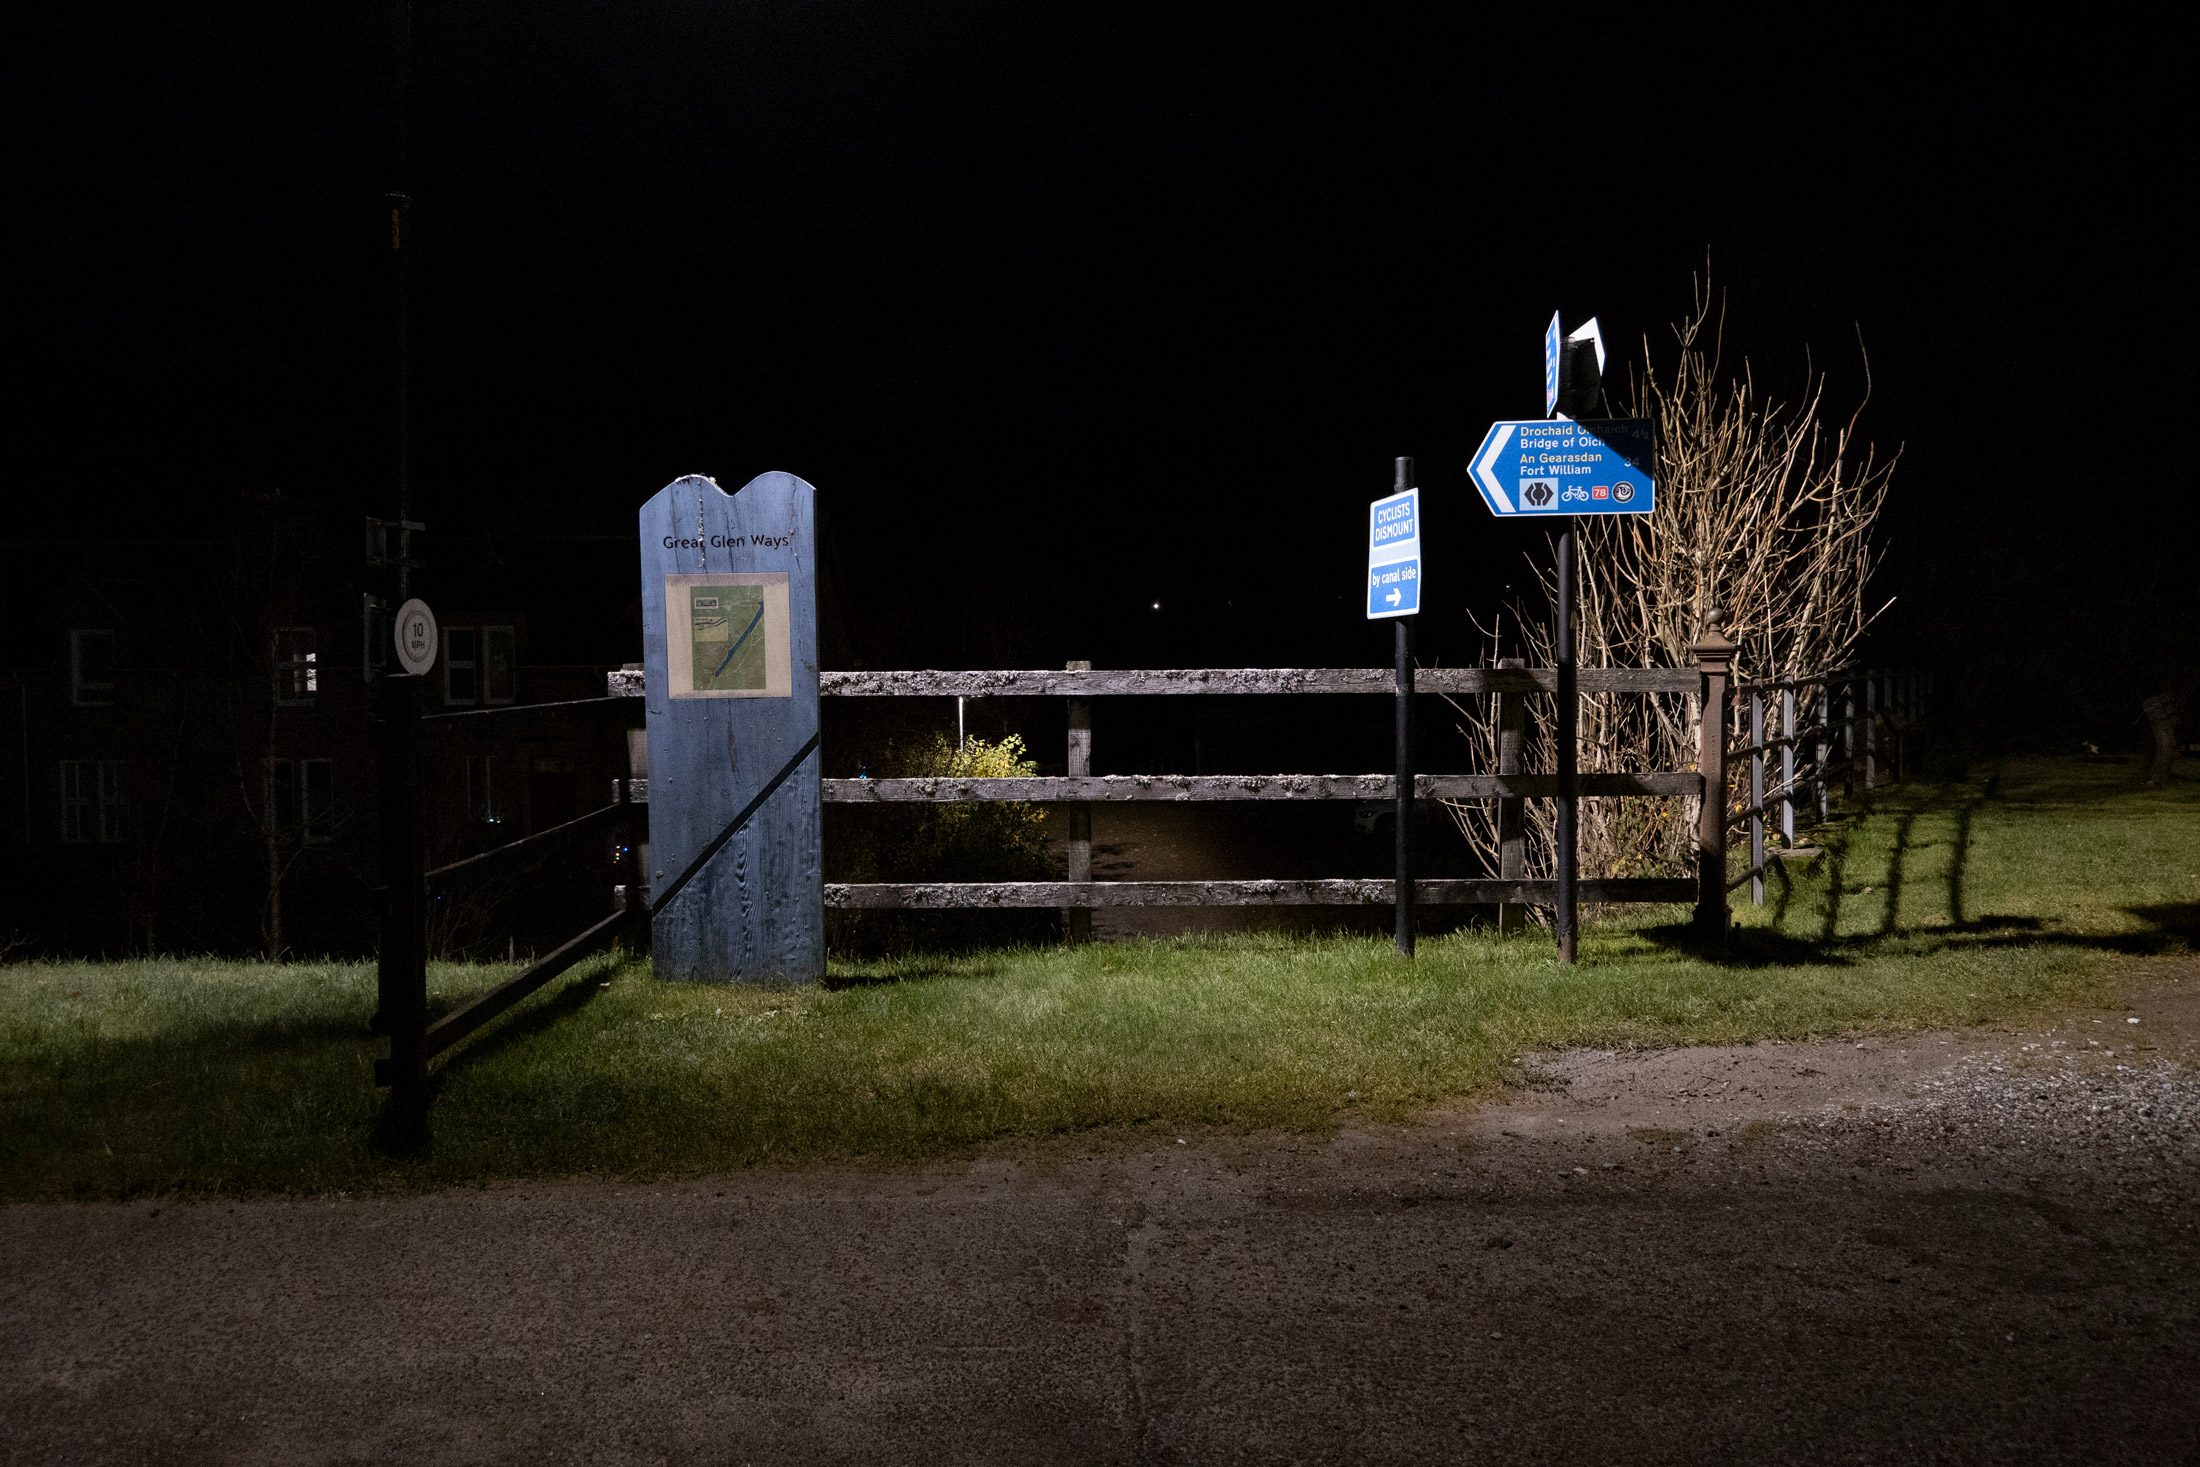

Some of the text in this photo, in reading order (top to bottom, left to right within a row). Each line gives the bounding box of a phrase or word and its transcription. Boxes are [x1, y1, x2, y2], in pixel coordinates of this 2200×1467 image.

[1520, 426, 1573, 437] Drochaid
[1520, 436, 1606, 450] Bridge of Oich
[1520, 452, 1602, 464] An Gearasdan
[1624, 457, 1640, 468] 34
[1520, 464, 1592, 476] Fort William
[1594, 488, 1607, 498] 78
[1378, 502, 1410, 524] CYCLISTS
[1375, 519, 1413, 541] DISMOUNT
[663, 534, 789, 550] Great Glen Ways
[1372, 566, 1416, 588] by canal side
[412, 622, 424, 637] 10
[411, 640, 425, 649] MPH
